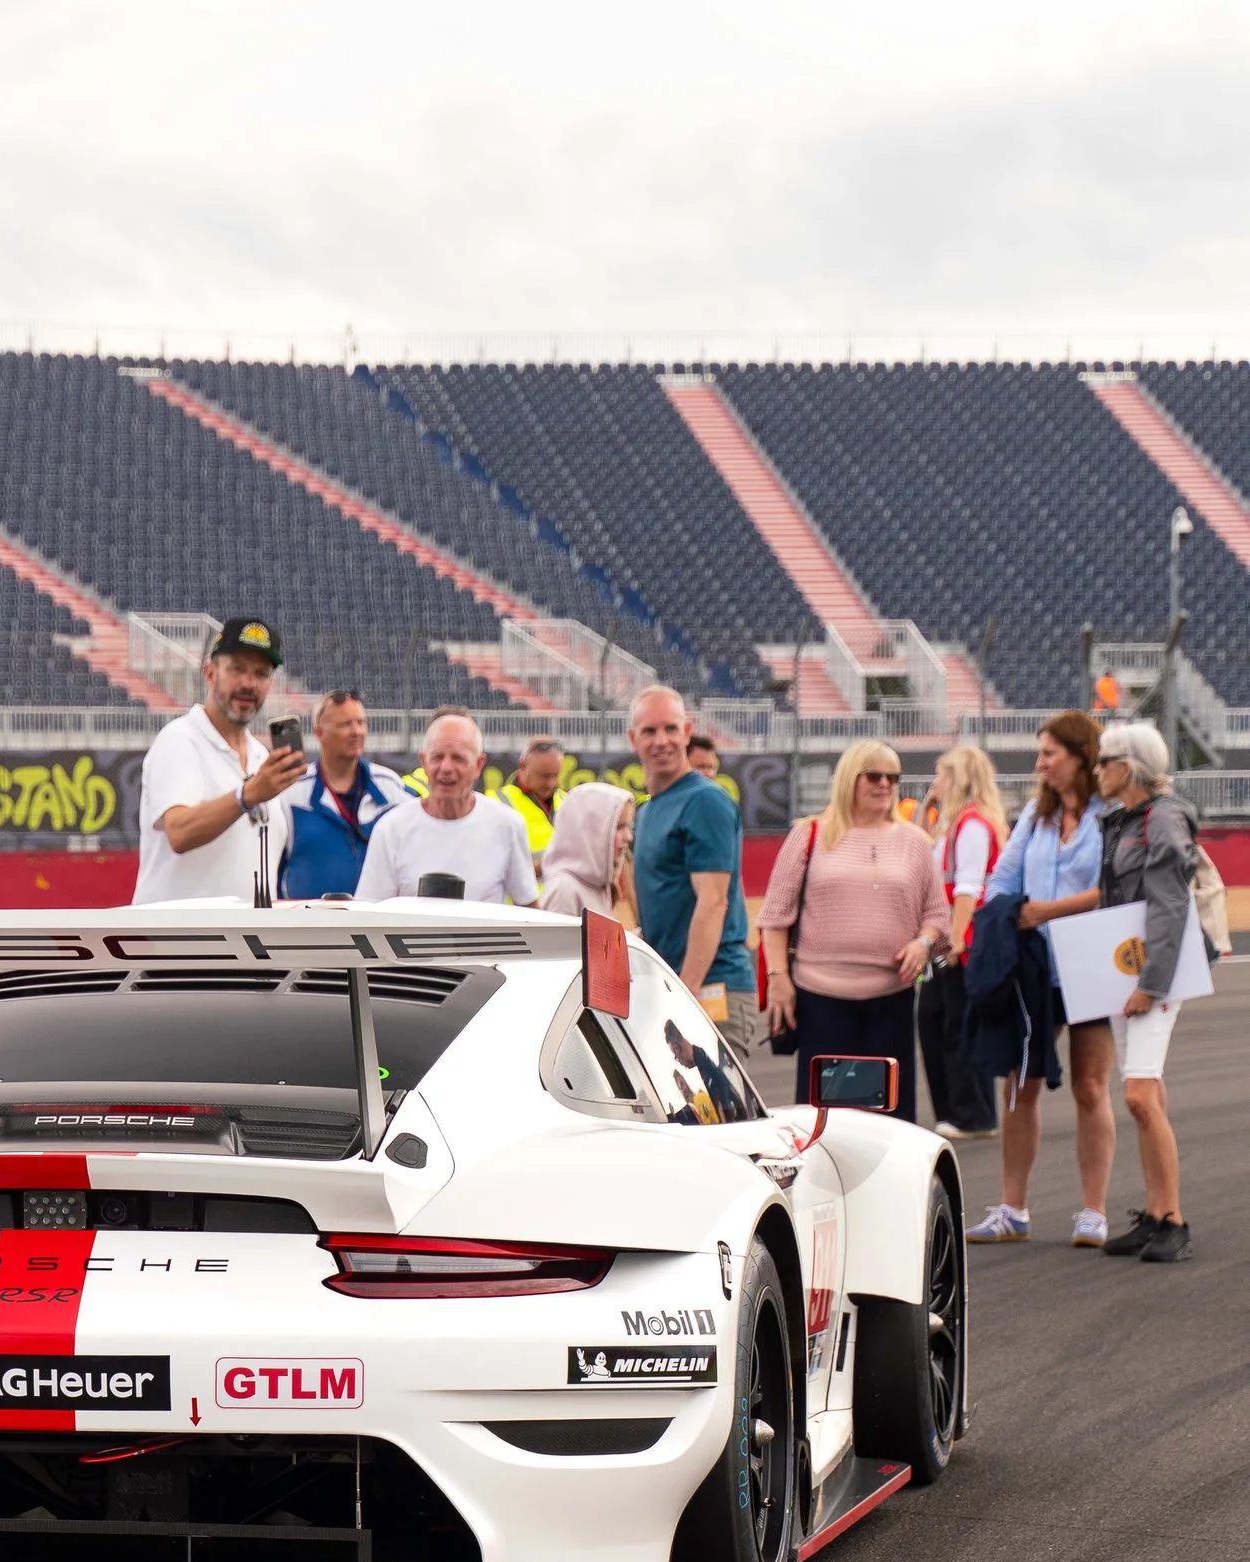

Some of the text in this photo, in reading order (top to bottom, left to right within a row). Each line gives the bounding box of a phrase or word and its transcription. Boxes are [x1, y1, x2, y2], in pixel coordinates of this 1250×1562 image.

[34, 1115, 195, 1127] PORSCHE
[621, 1309, 694, 1336] Mobil
[613, 1357, 709, 1373] MICHELIN
[223, 1367, 356, 1399] GTLM
